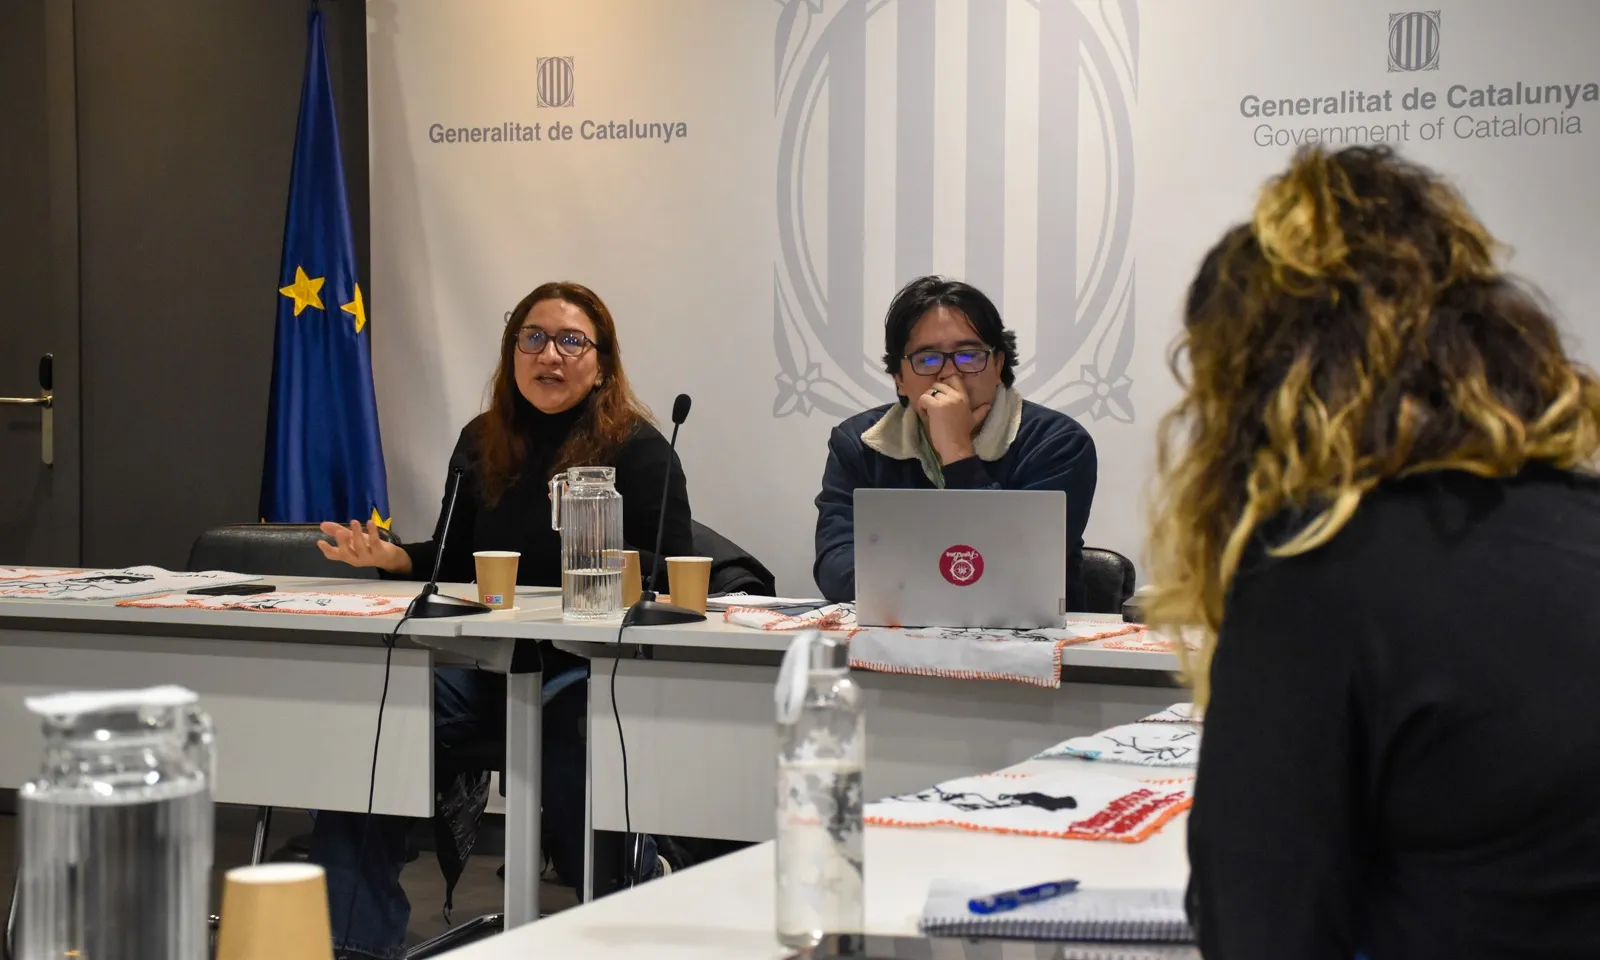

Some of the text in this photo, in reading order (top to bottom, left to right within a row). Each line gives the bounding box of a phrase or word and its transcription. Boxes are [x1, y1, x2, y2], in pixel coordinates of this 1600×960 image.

[1240, 81, 1600, 118] Generalitat de Catalunya
[429, 119, 687, 143] Generalitat de Catalunya
[1253, 111, 1582, 147] Government of Catalonia
